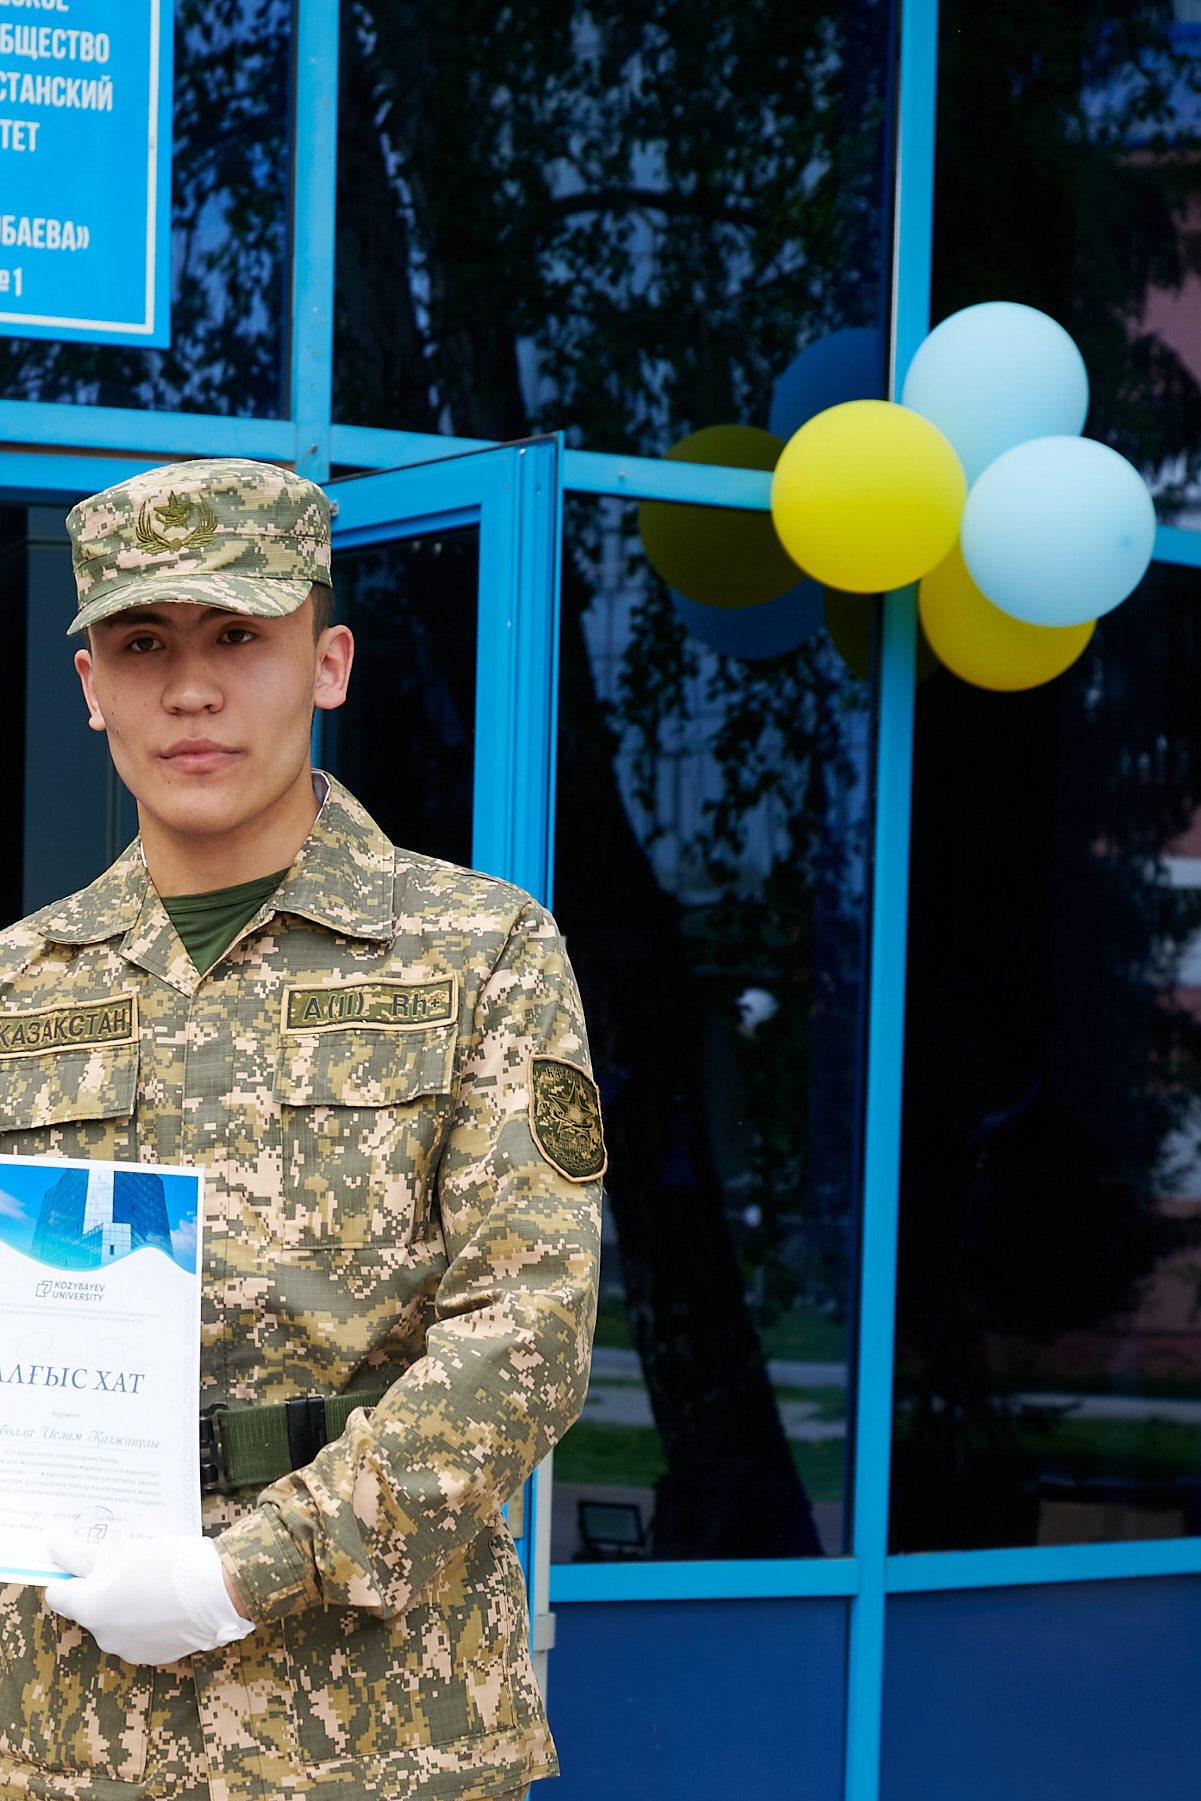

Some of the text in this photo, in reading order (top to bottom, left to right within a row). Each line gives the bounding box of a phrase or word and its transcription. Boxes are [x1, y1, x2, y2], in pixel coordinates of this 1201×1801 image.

[392, 993, 441, 1017] Rh+
[52, 1290, 105, 1302] UNIVERSITY
[54, 1281, 106, 1293] KOZYBAYEV
[94, 1370, 146, 1394] ХАТ
